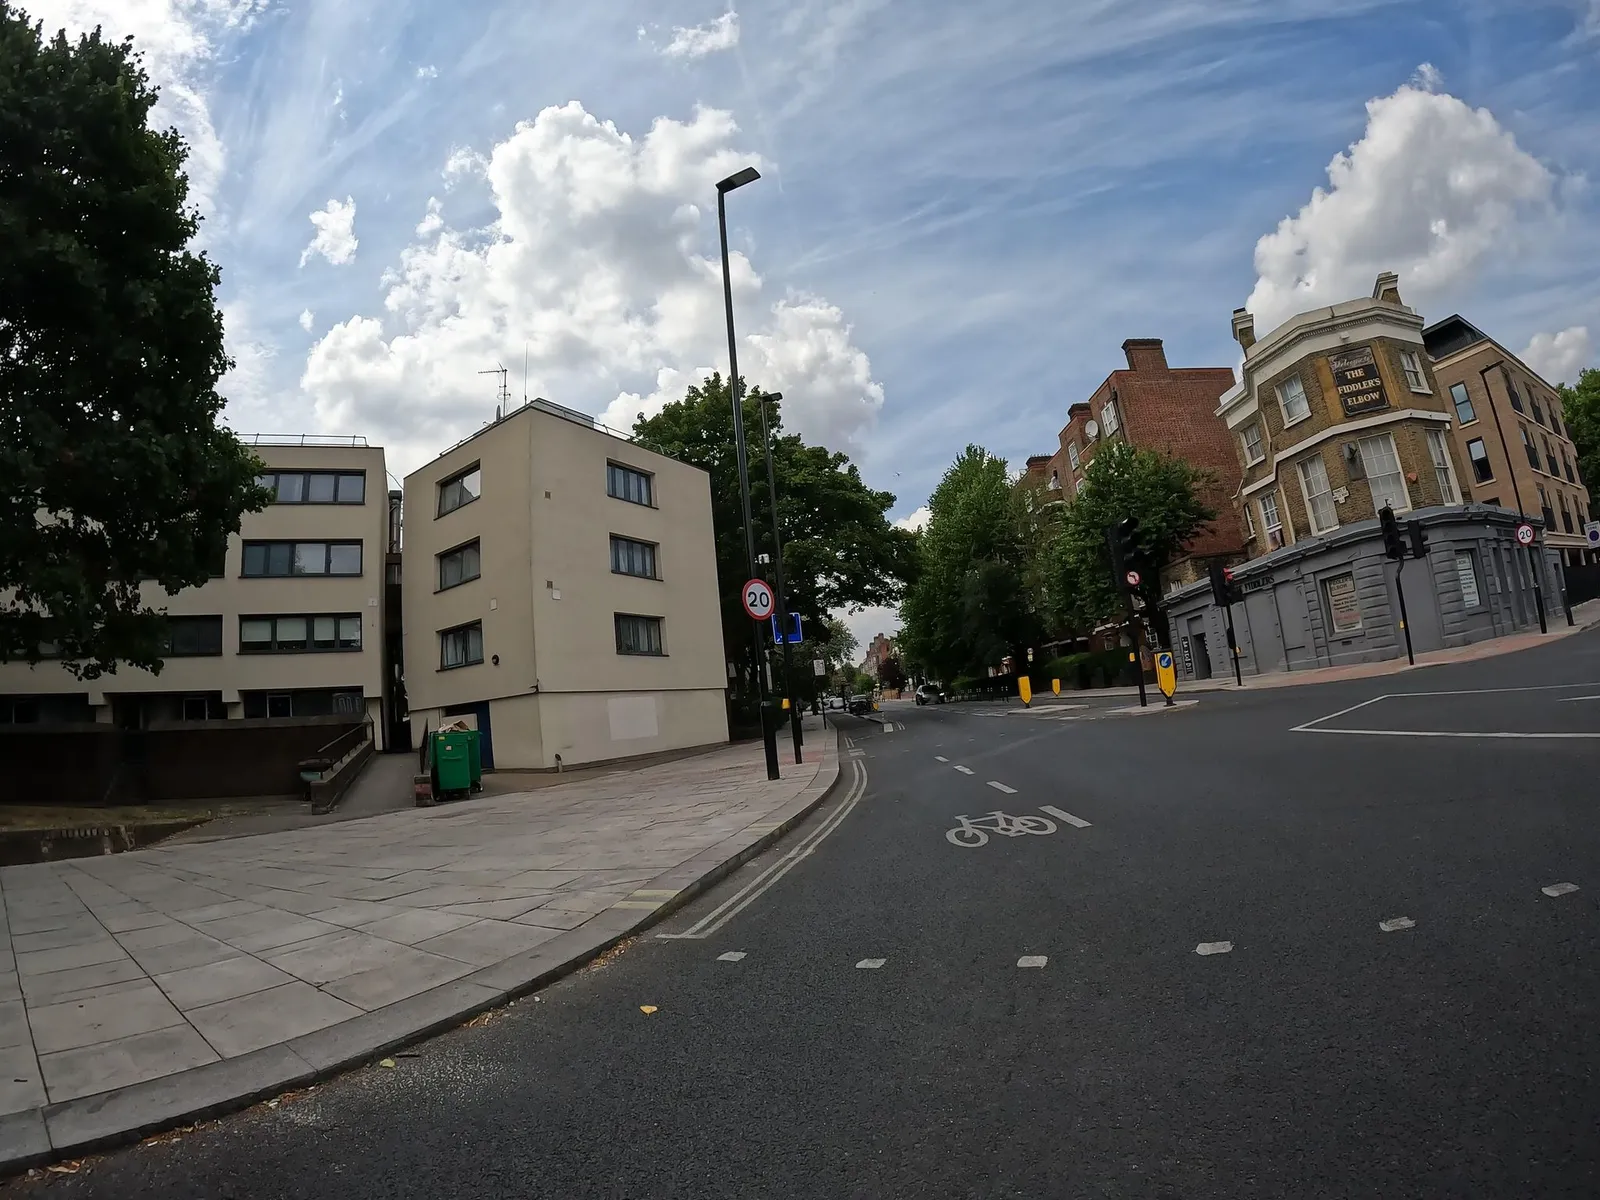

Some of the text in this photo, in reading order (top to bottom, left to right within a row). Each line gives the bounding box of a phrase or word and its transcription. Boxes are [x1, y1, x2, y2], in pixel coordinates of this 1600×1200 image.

[1345, 368, 1365, 379] THE
[1337, 378, 1381, 394] FIDDLER'S
[1347, 392, 1379, 406] ELBOW
[1520, 529, 1532, 540] 20
[748, 591, 770, 608] 20
